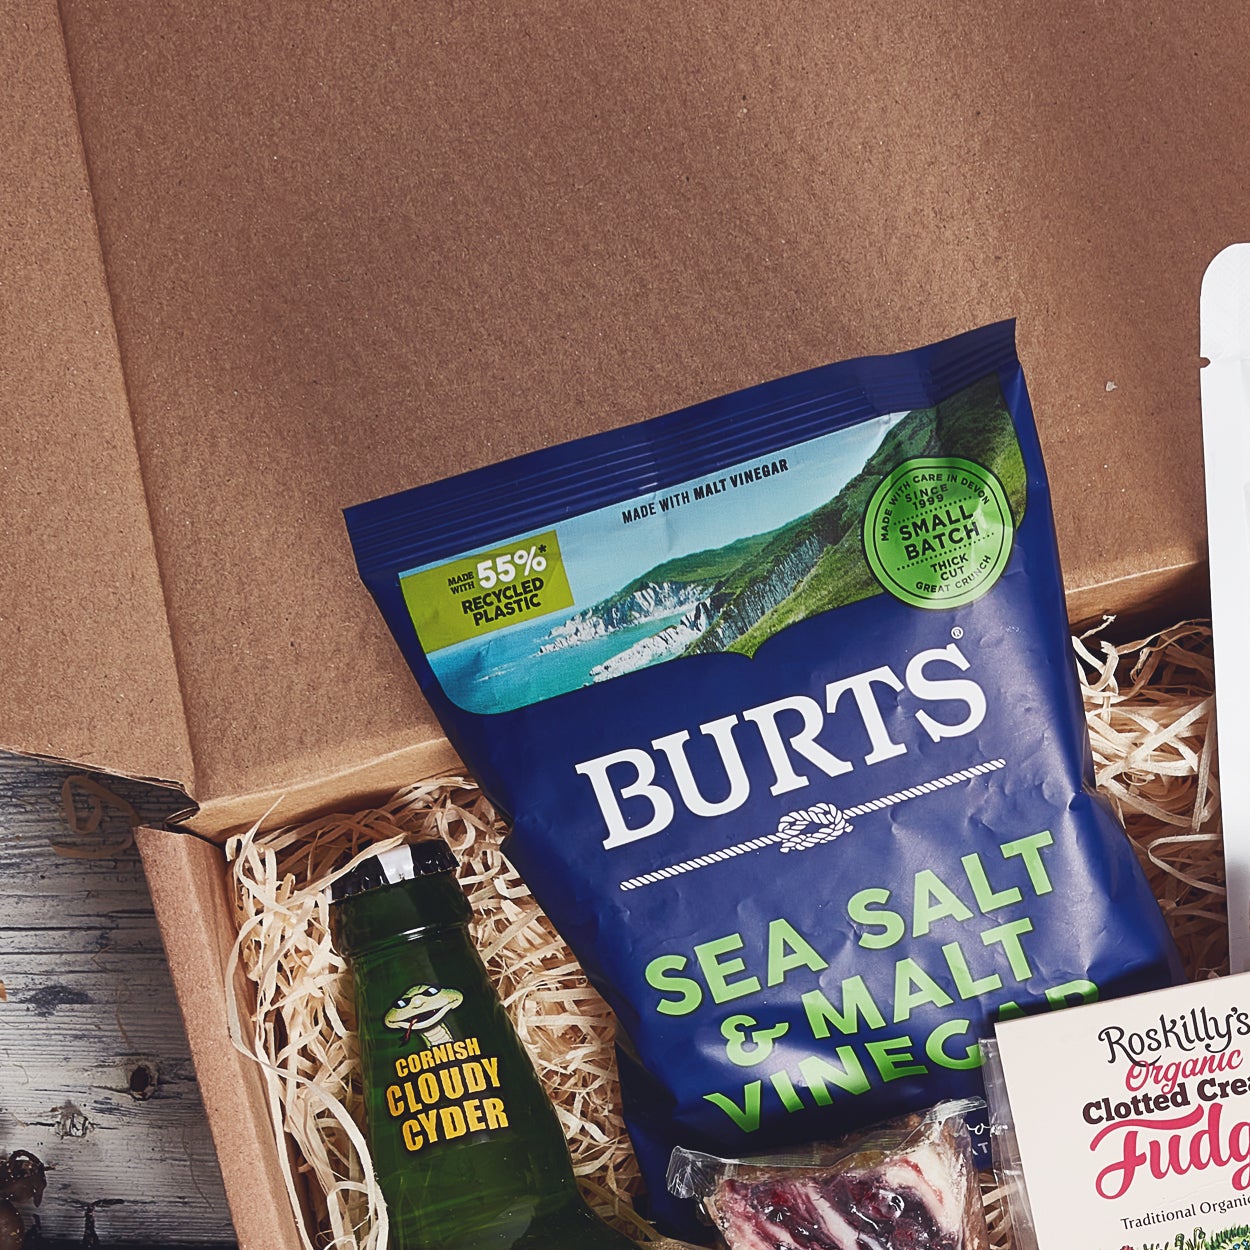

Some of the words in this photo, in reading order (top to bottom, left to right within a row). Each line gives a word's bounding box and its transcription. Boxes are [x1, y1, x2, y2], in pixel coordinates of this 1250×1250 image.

[622, 503, 656, 524] MADE
[659, 491, 690, 512] WITH
[693, 479, 727, 500] MALT
[730, 459, 788, 487] VINEGAR
[881, 508, 892, 541] MADE
[889, 481, 909, 506] WITH
[913, 474, 943, 484] CARE
[947, 474, 957, 483] IN
[961, 477, 990, 505] DEVON
[904, 484, 949, 503] SINCE
[912, 493, 944, 511] 1999
[900, 504, 973, 541] SMALL
[904, 522, 979, 561] BATCH
[447, 571, 474, 587] MADE
[916, 581, 950, 593] GREAT
[955, 555, 992, 589] CRUNCH
[930, 553, 968, 573] THICK
[940, 565, 965, 581] CUT
[450, 581, 475, 595] WITH
[461, 577, 544, 614] RECYCLED
[473, 593, 541, 626] PLASTIC
[575, 643, 987, 850] BURTS
[644, 918, 829, 1016] SEA
[846, 830, 1055, 950] SALT
[719, 1014, 788, 1067] &
[801, 917, 1035, 1038] MALT
[395, 1037, 482, 1078] CORNISH
[703, 979, 1099, 1132] VINEG
[1125, 1048, 1243, 1095] Organic
[386, 1057, 501, 1117] CLOUDY
[1082, 1083, 1190, 1125] Clotted
[402, 1097, 509, 1152] CYDER
[1120, 1205, 1196, 1231] Traditional
